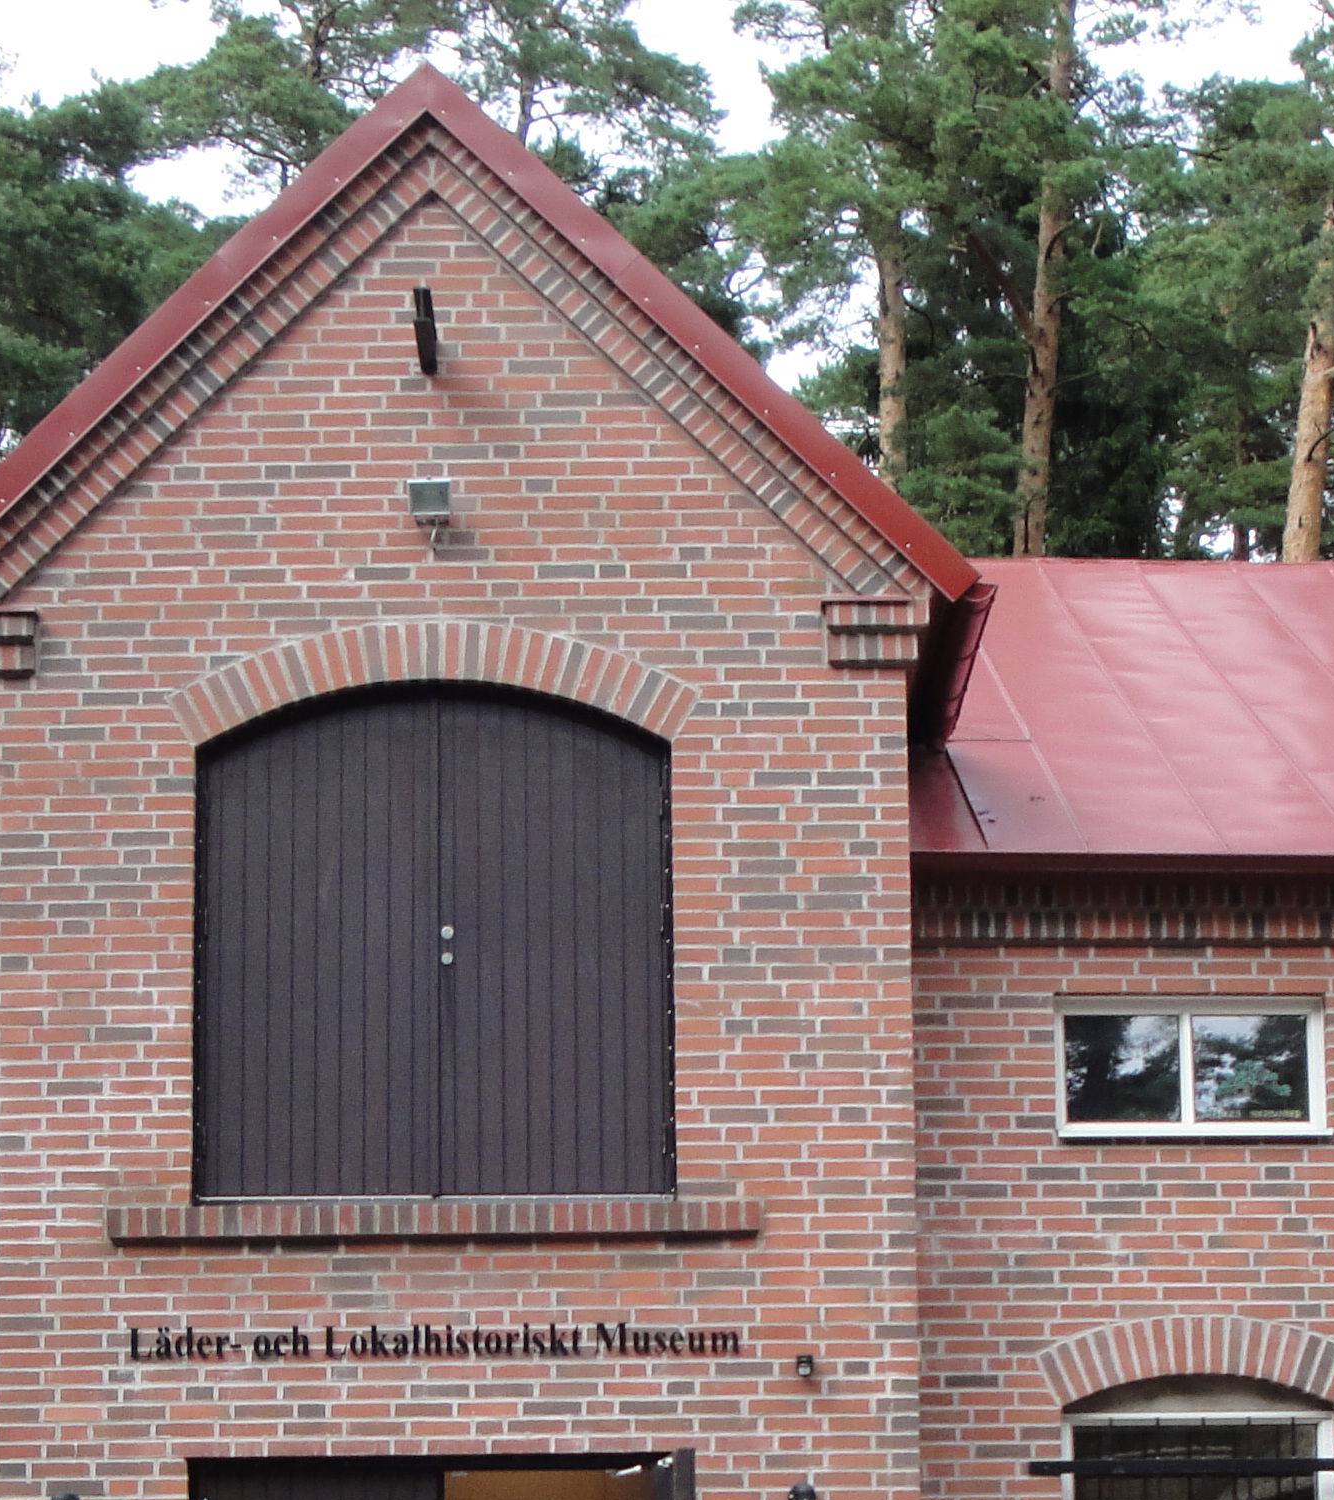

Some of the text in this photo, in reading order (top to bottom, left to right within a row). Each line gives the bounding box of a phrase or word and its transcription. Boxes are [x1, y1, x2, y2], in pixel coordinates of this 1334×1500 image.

[130, 1321, 740, 1360] Läder- och Lokalhistoriskt Museum
